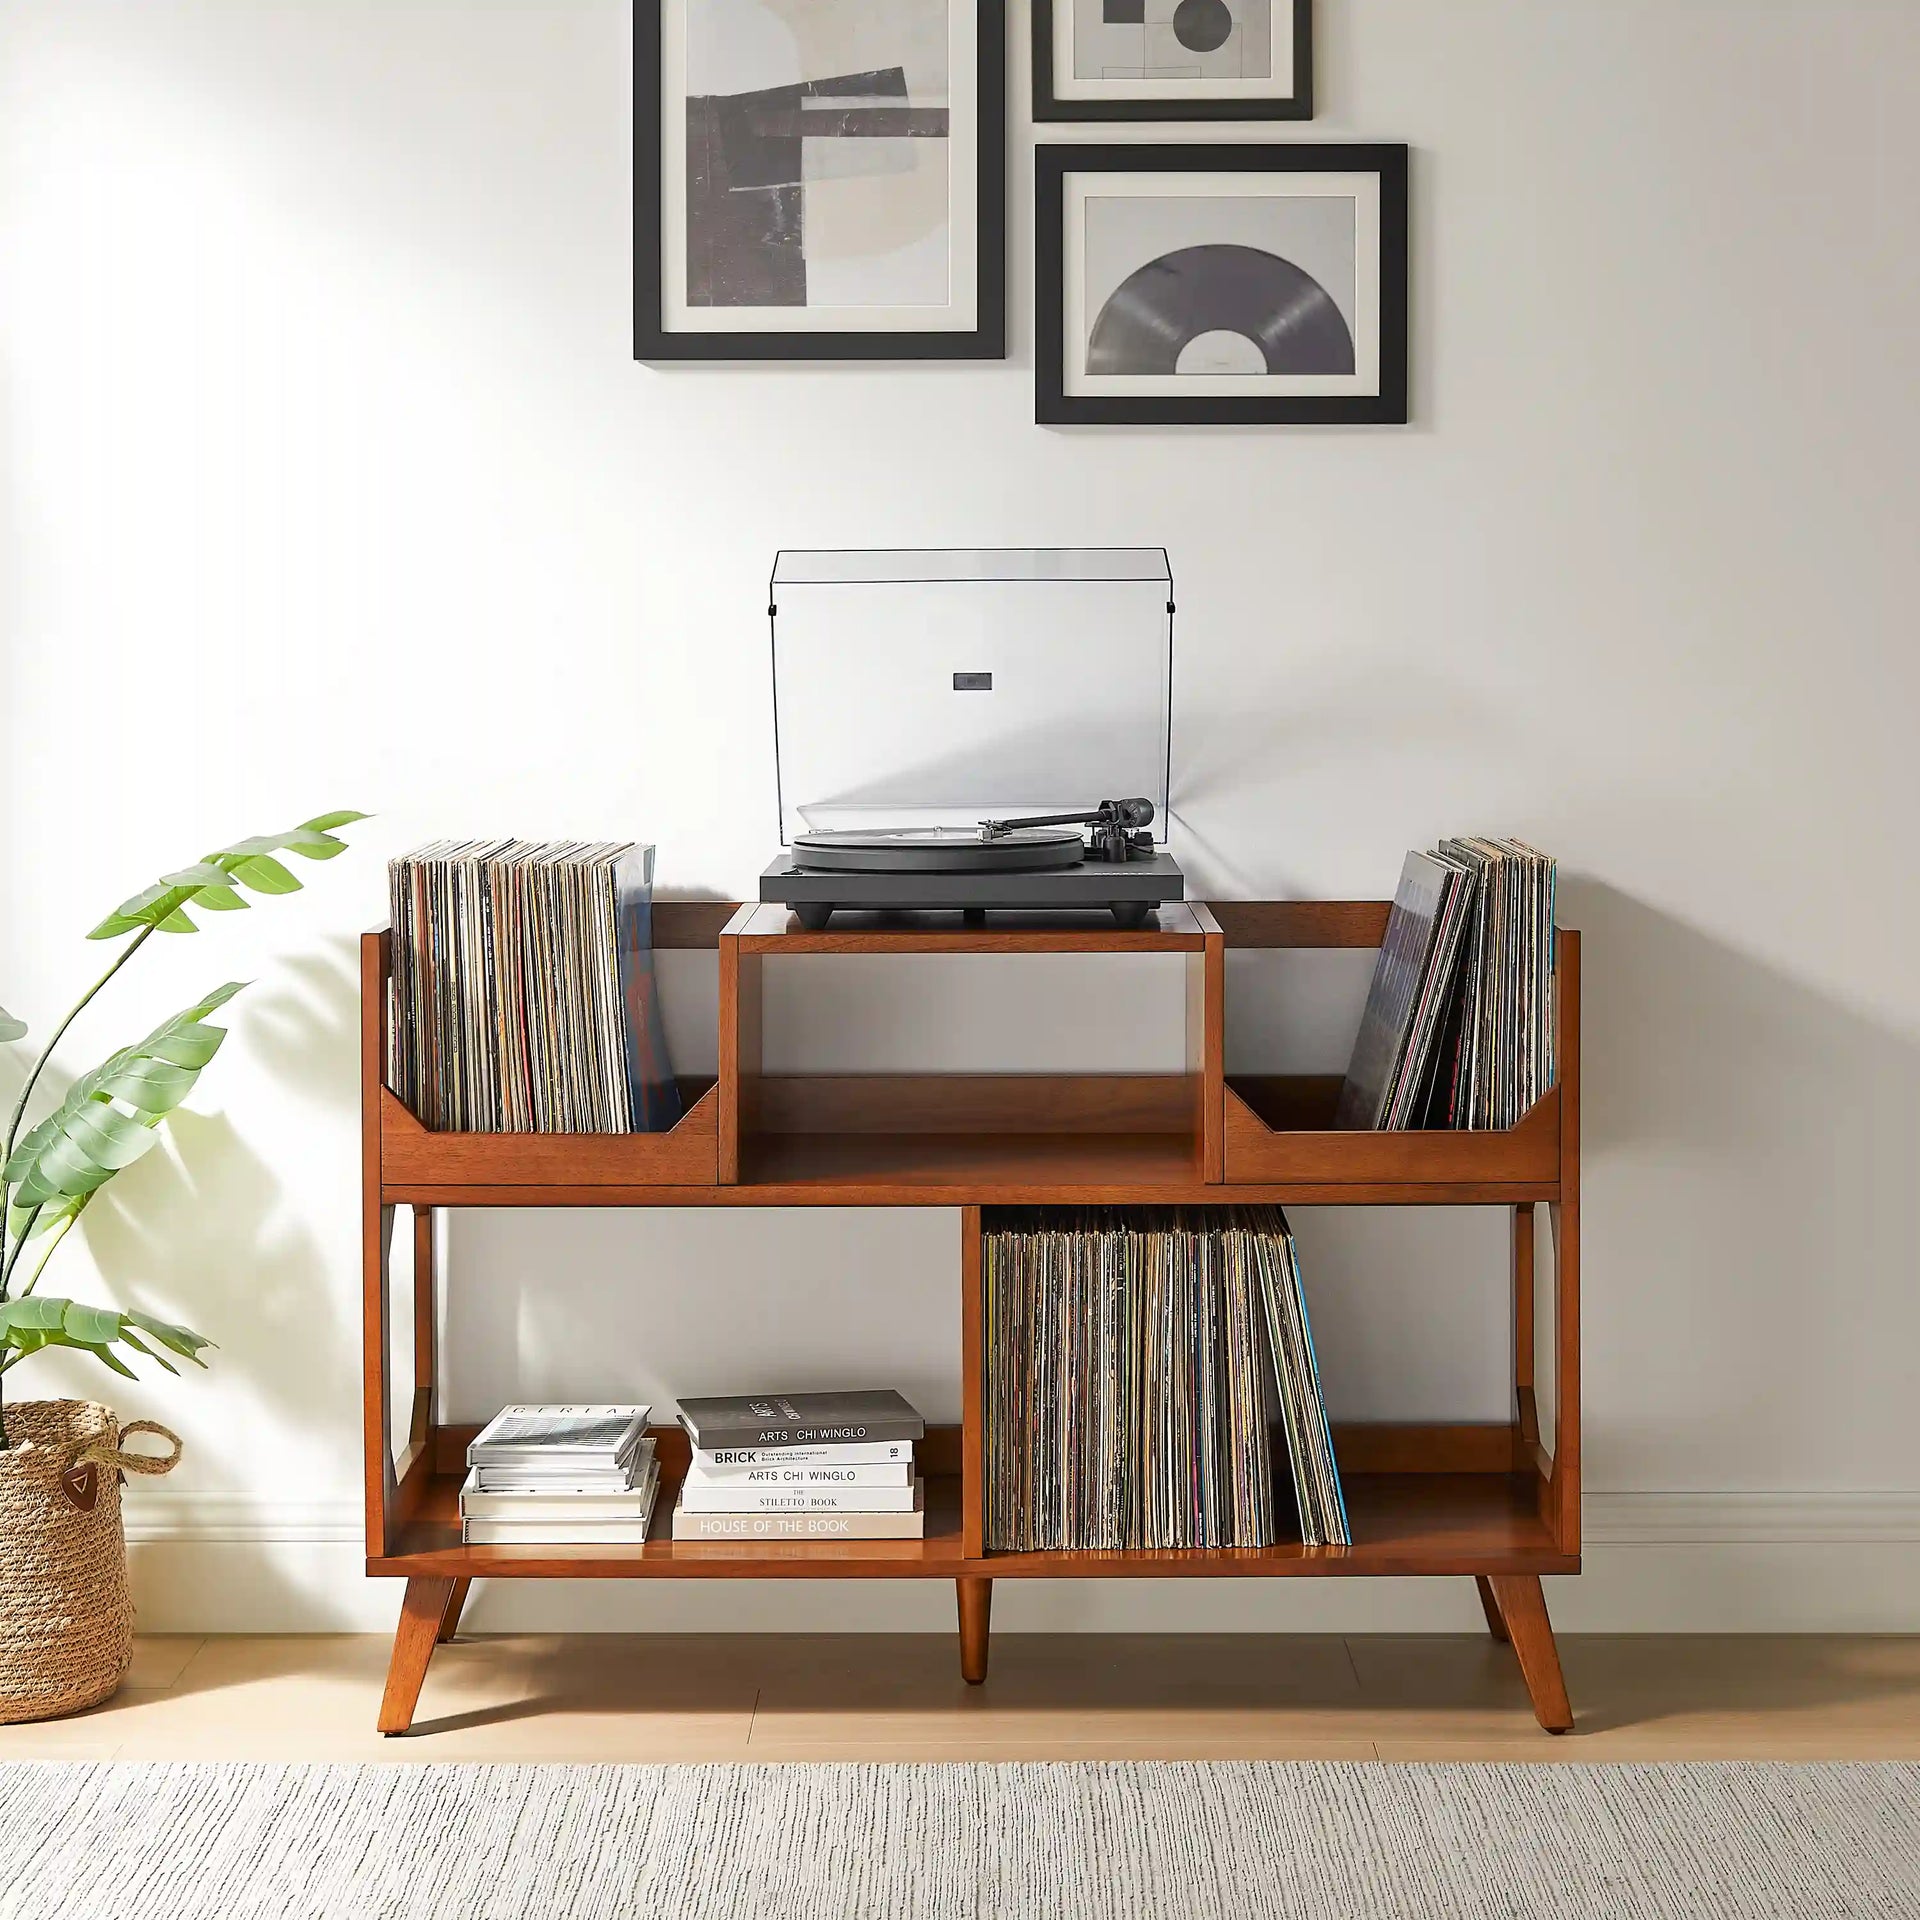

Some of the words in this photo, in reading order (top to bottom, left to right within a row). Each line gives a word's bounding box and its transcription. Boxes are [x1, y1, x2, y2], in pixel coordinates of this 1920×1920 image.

[758, 1430, 789, 1442] ARTS
[796, 1429, 817, 1440] CHI
[819, 1427, 866, 1438] WINGLO
[714, 1451, 757, 1464] BRICK
[889, 1447, 899, 1458] 18
[748, 1471, 778, 1480] ARTS
[783, 1471, 804, 1480] CHI
[808, 1470, 856, 1481] WINGLO
[759, 1498, 805, 1506] STILETTO
[810, 1498, 838, 1506] BOOK
[700, 1520, 749, 1533] HOUSE
[753, 1520, 772, 1533] OF
[776, 1520, 804, 1532] THE
[808, 1519, 849, 1532] BOOK
